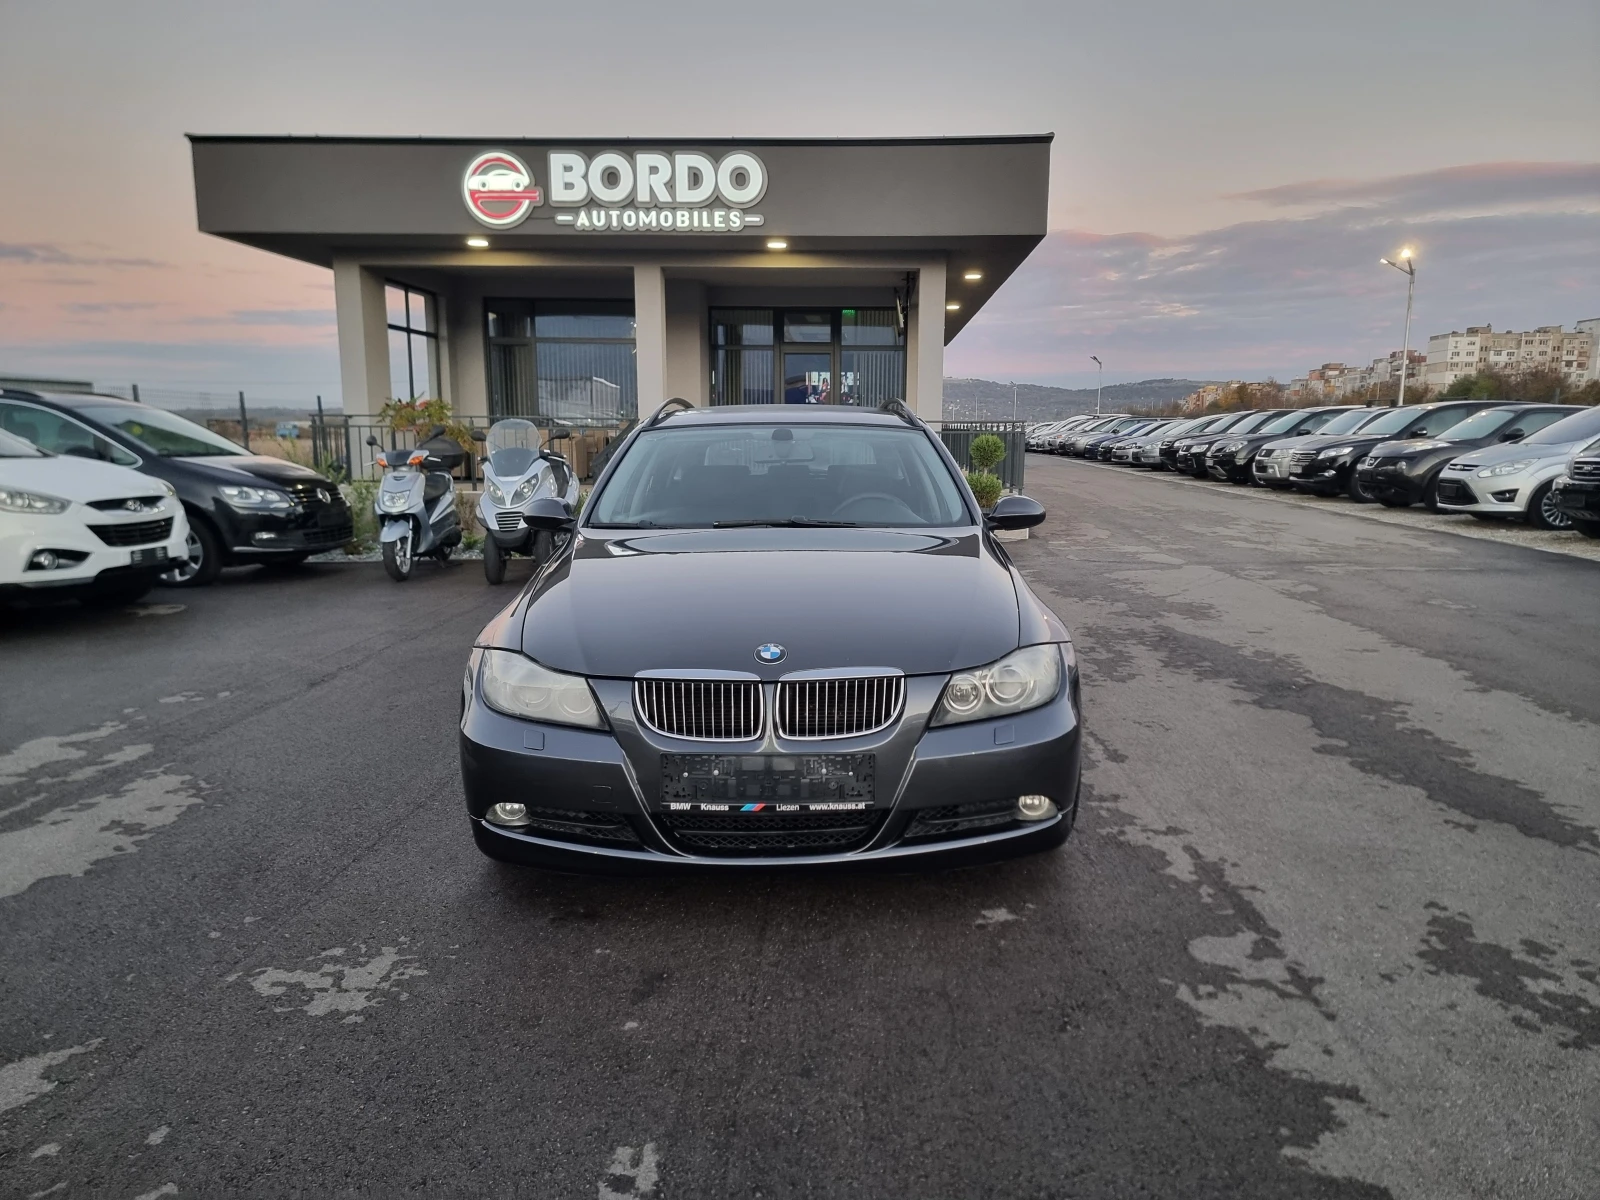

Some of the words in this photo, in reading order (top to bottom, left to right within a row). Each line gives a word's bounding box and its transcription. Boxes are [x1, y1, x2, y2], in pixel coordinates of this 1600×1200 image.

[549, 153, 763, 203] BORDO
[576, 210, 741, 228] AUTOMOBILES
[670, 802, 692, 811] BMW
[700, 803, 729, 811] Knauss
[776, 803, 800, 811] Liezen
[809, 802, 866, 811] www.knauss.at
